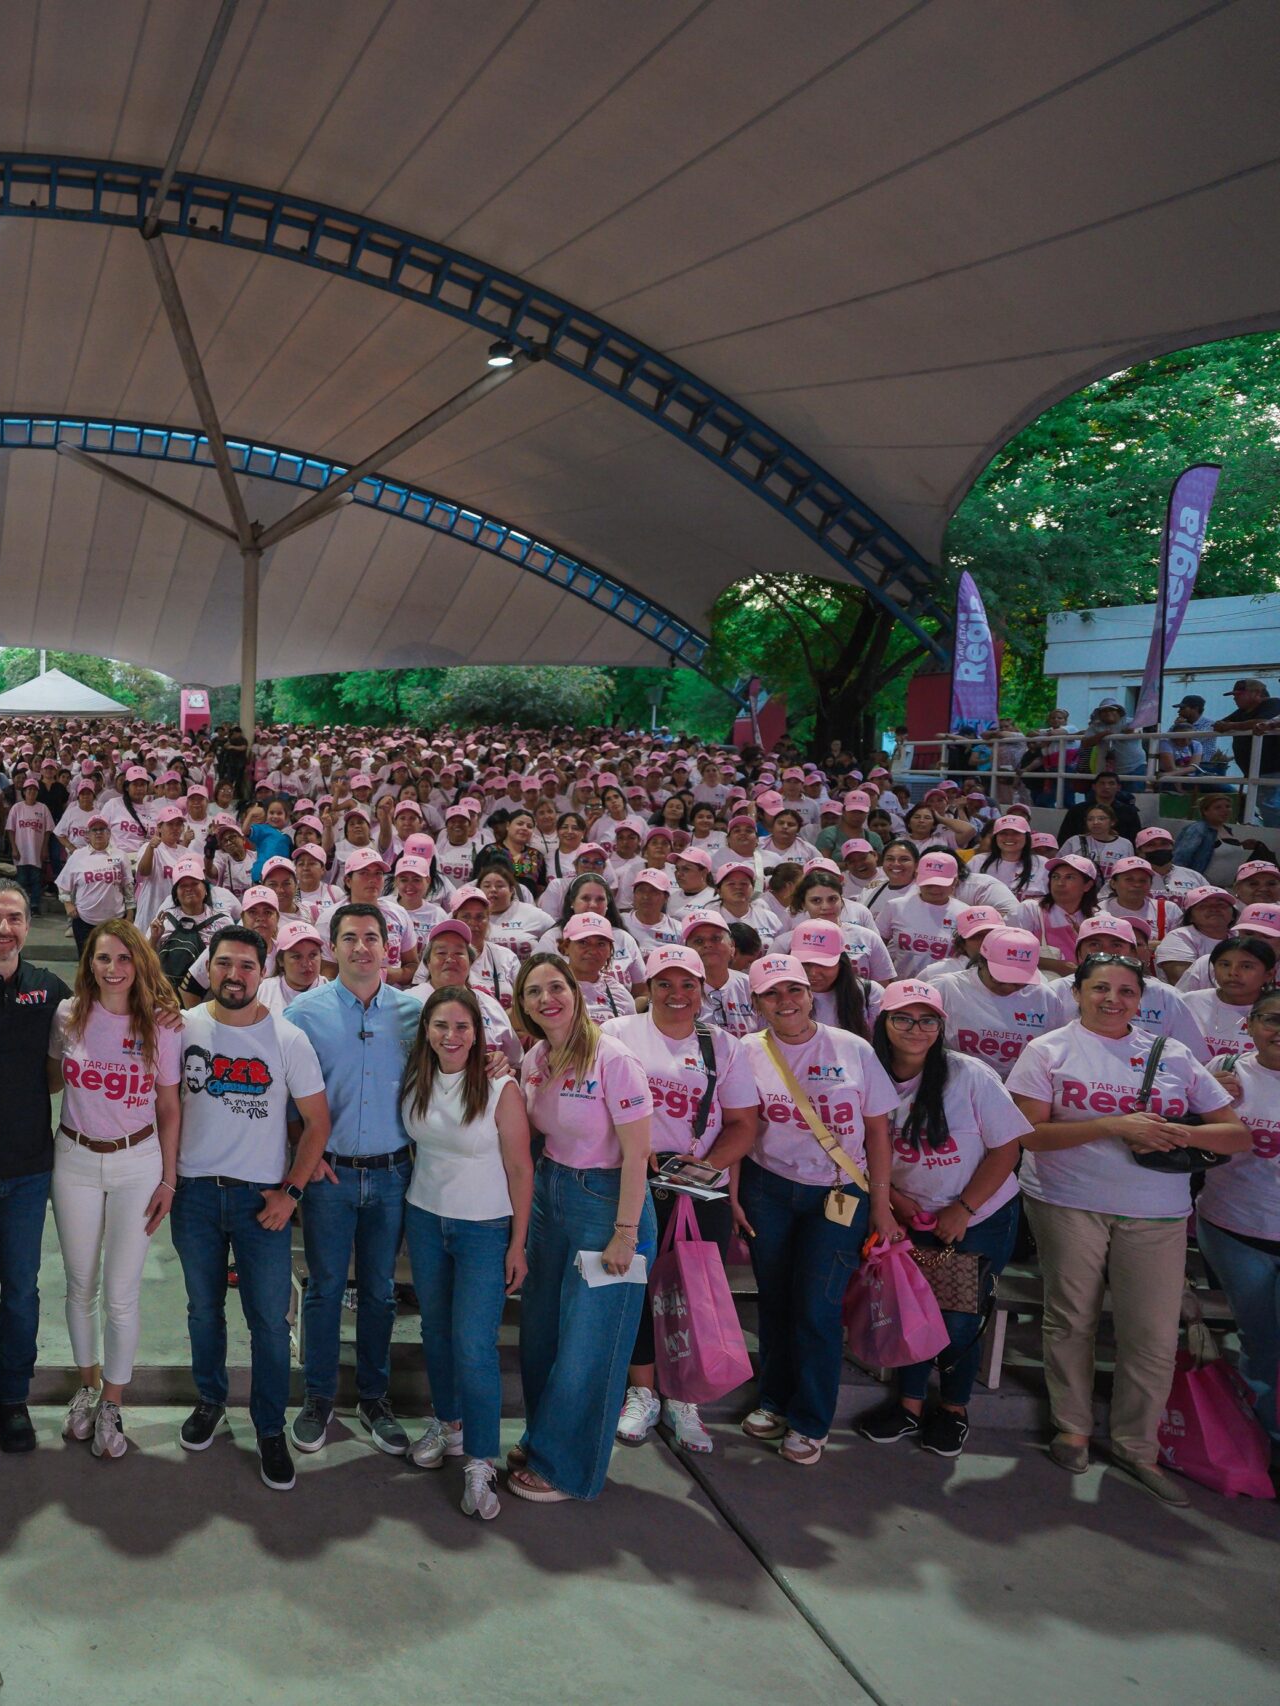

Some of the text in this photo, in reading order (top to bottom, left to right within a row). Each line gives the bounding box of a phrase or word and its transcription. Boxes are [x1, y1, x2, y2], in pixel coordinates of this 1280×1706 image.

[19, 820, 44, 831] Regia
[84, 868, 123, 884] Regia
[803, 933, 826, 942] MTY
[913, 933, 948, 942] TARJETA
[660, 952, 684, 960] MTY
[1007, 949, 1032, 958] MTY
[762, 960, 788, 971] MTY
[903, 985, 928, 995] MTY
[16, 989, 48, 1005] MTY
[1014, 1011, 1044, 1024] MTY
[981, 1029, 1022, 1041] TARJETA
[122, 1038, 143, 1051] MT
[1204, 1037, 1239, 1047] ARJETA
[83, 1059, 127, 1072] TARJETA
[212, 1055, 272, 1086] FER
[808, 1065, 844, 1077] MTY
[63, 1057, 155, 1100] Regia
[563, 1079, 597, 1094] MTY
[767, 1093, 814, 1103] TARJA
[1240, 1117, 1280, 1129] RJETA
[894, 1128, 958, 1163] gia
